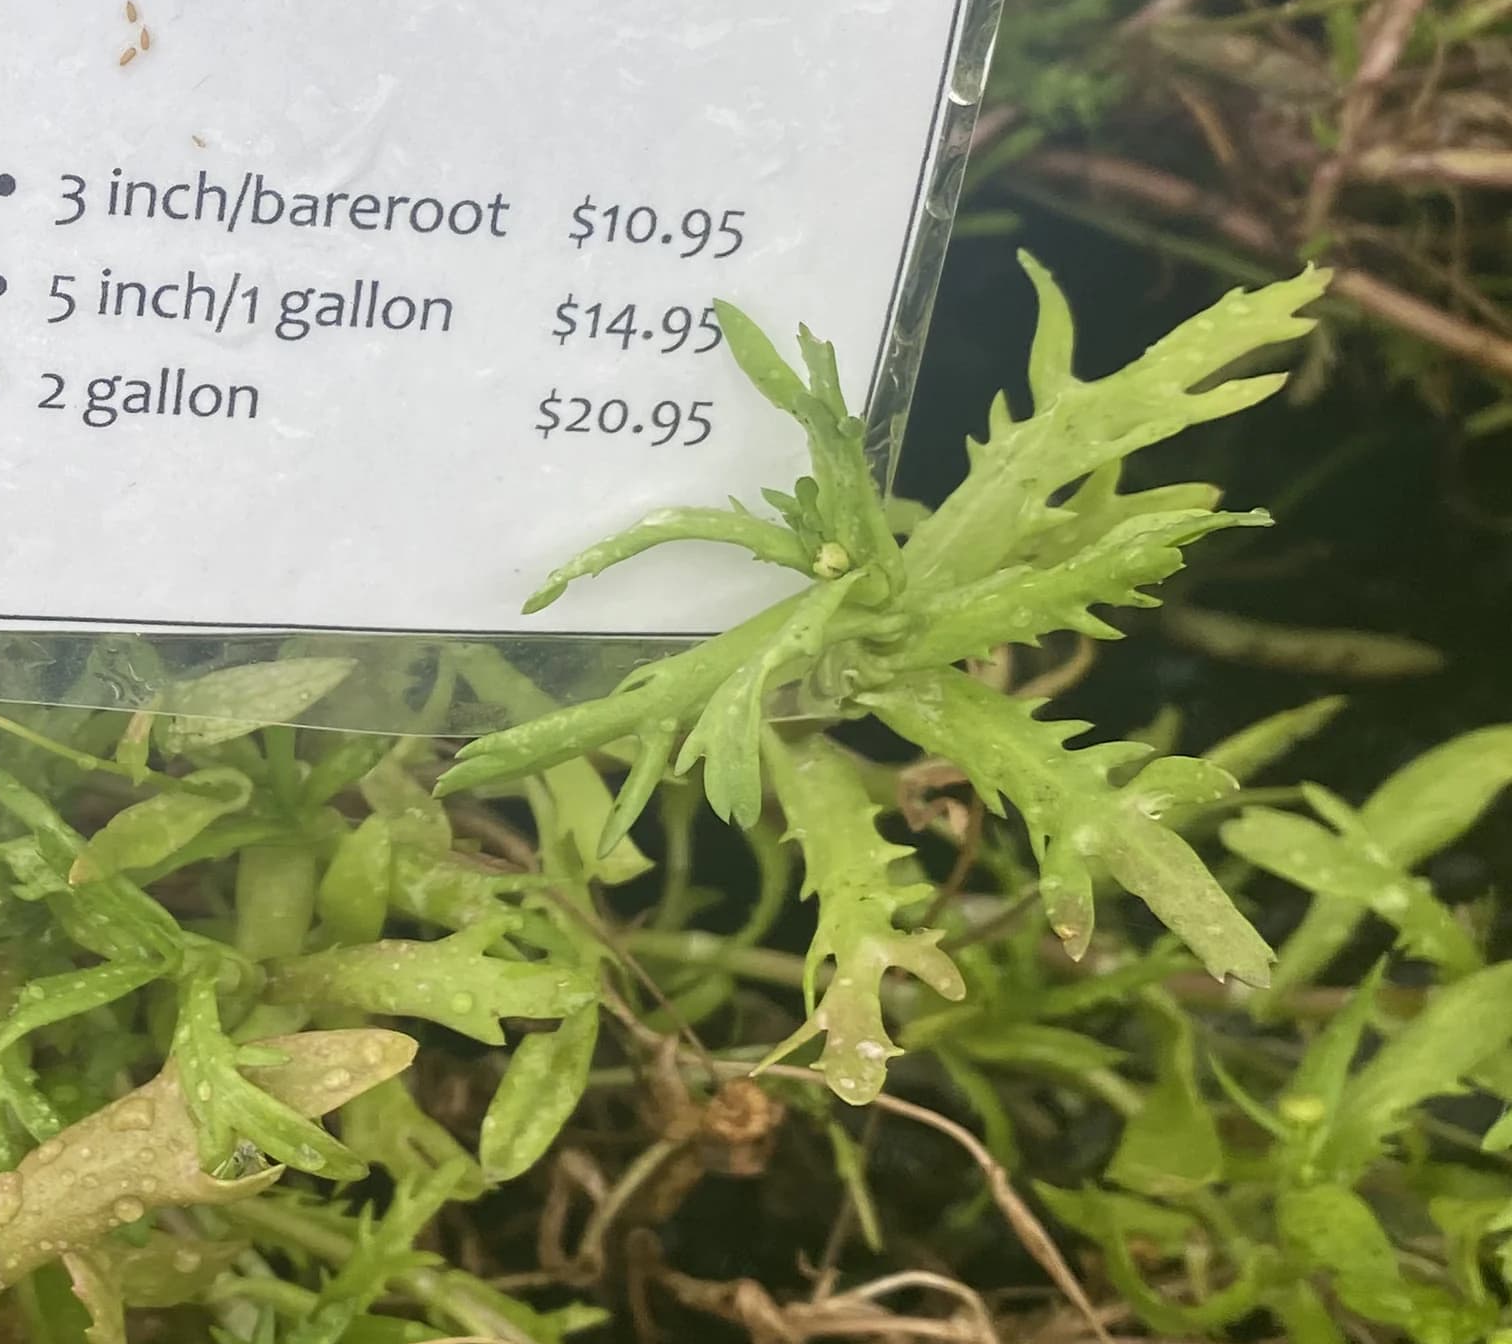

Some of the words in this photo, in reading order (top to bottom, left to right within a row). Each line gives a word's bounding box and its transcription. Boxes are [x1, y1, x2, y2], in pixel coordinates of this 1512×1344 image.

[54, 173, 87, 226] 3
[107, 168, 511, 239] inch/bareroot
[568, 195, 746, 259] $10.95
[47, 274, 76, 324] 5
[97, 268, 259, 334] inch/1
[276, 279, 455, 342] gallon
[552, 294, 724, 353] $14.95
[37, 372, 66, 411] 2
[84, 368, 260, 428] gallon
[534, 389, 714, 447] $20.95
